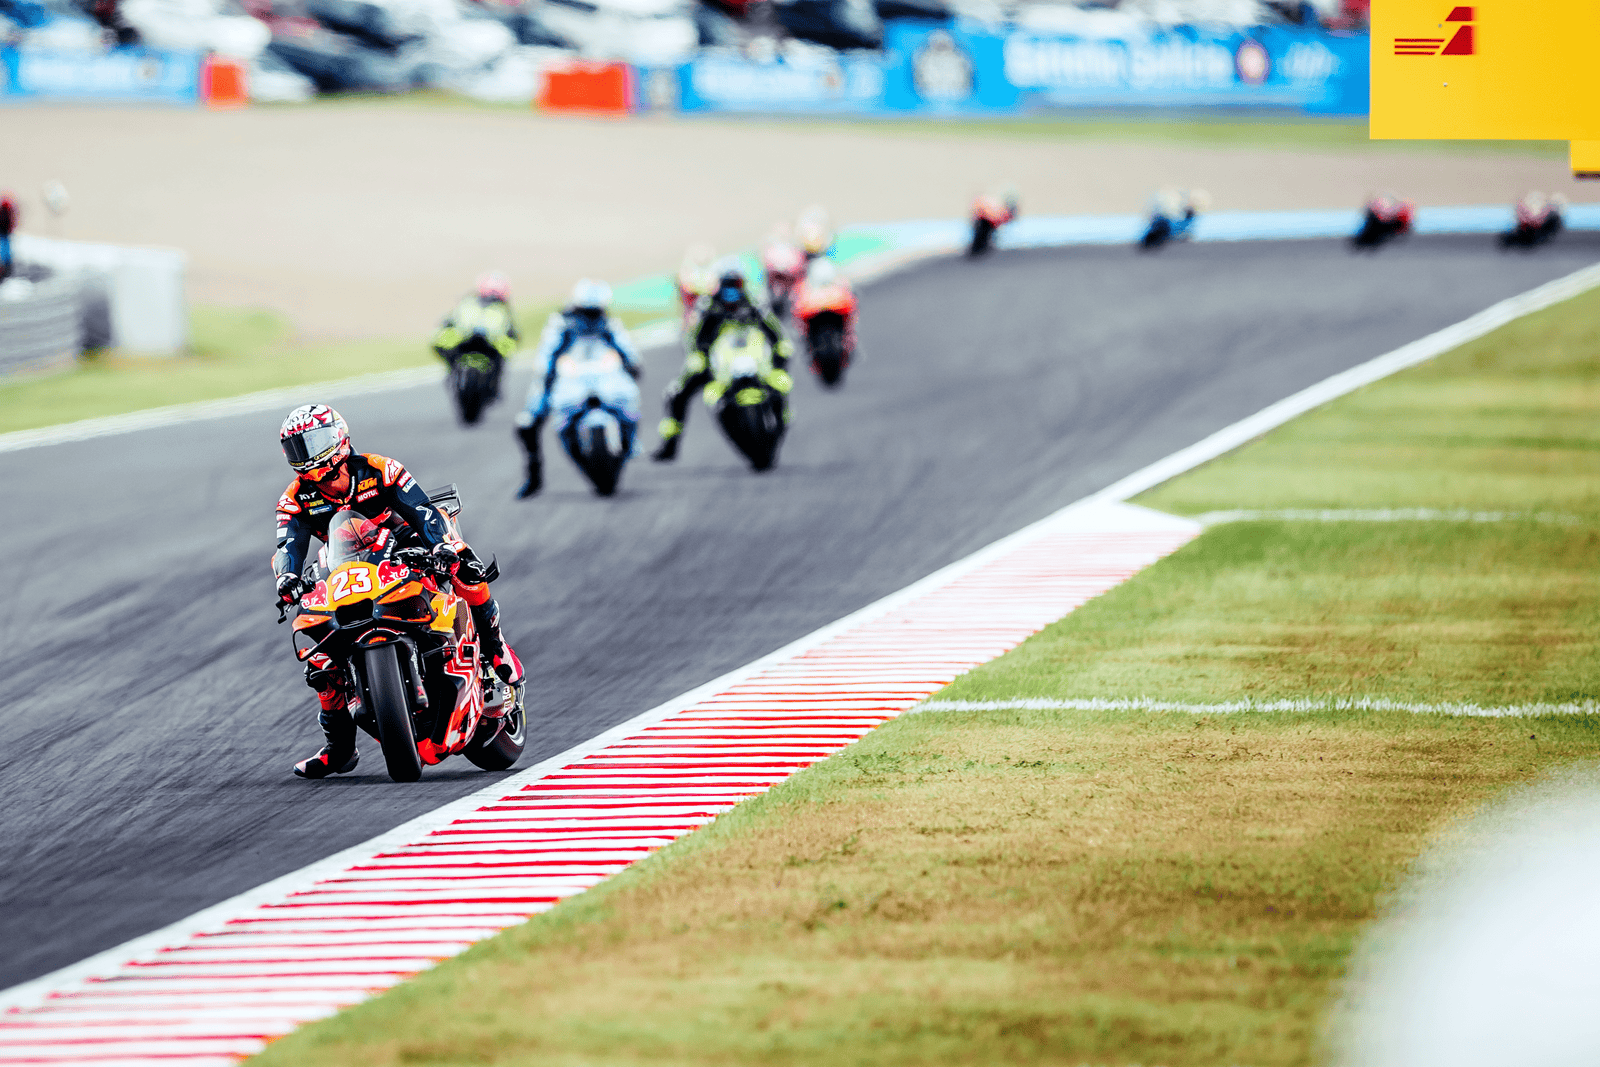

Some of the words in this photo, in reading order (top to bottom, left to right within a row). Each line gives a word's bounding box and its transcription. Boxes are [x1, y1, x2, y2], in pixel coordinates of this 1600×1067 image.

[357, 477, 378, 493] KTM
[298, 491, 317, 501] KYT
[357, 489, 378, 502] MOTUL
[331, 567, 373, 602] 23
